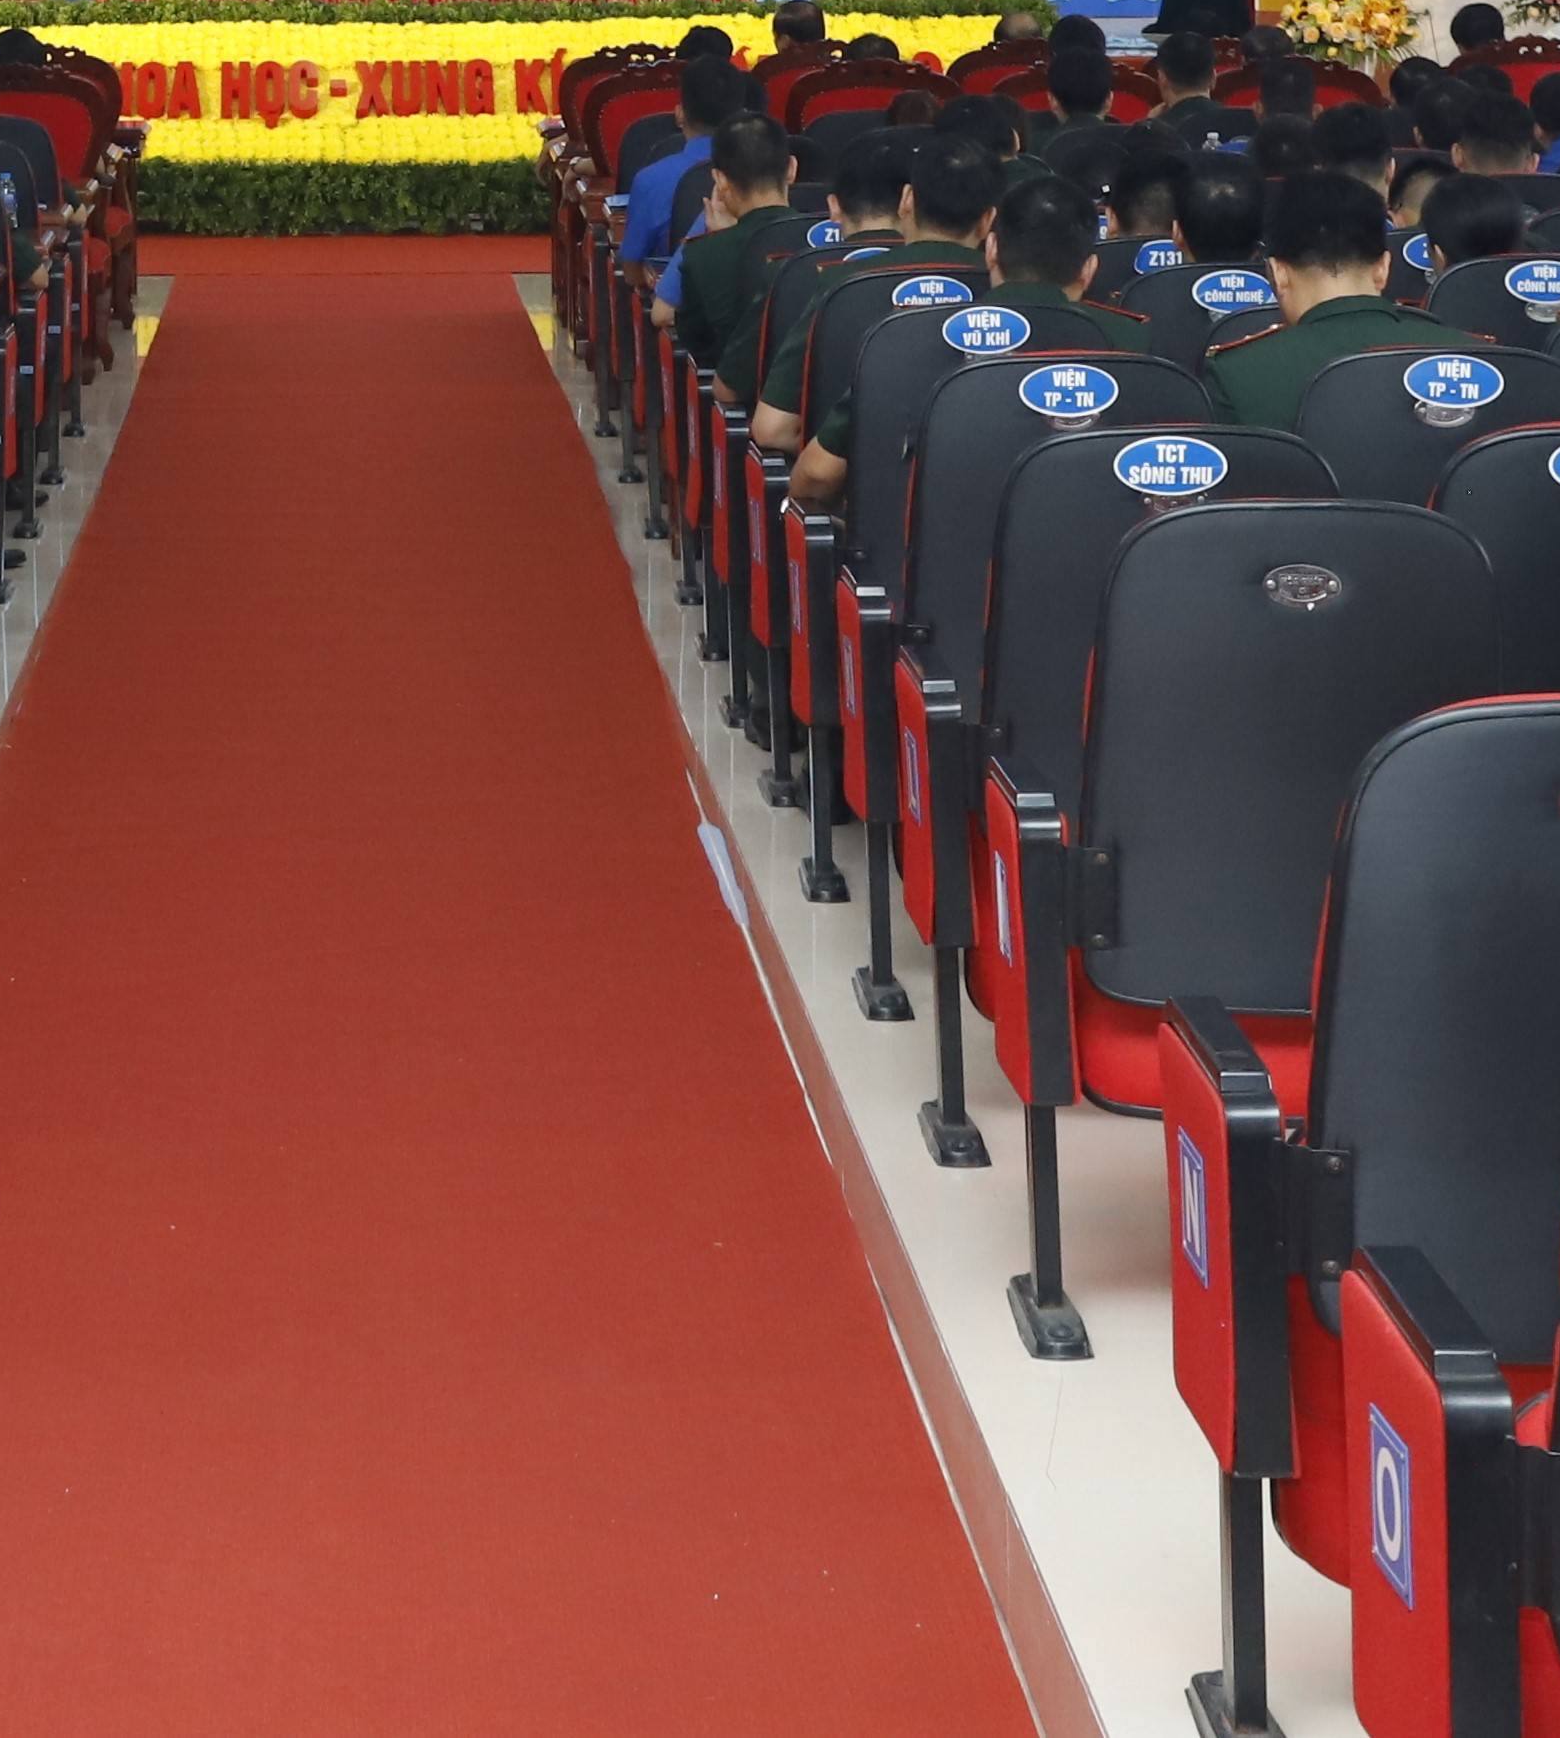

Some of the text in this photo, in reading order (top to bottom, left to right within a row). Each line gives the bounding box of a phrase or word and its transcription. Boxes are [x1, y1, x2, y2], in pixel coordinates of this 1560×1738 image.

[221, 59, 494, 129] HỌC - XUNG
[1044, 391, 1061, 407] TP
[1075, 391, 1094, 407] TN
[1052, 368, 1085, 390] VIỆN
[1183, 1156, 1200, 1258] N
